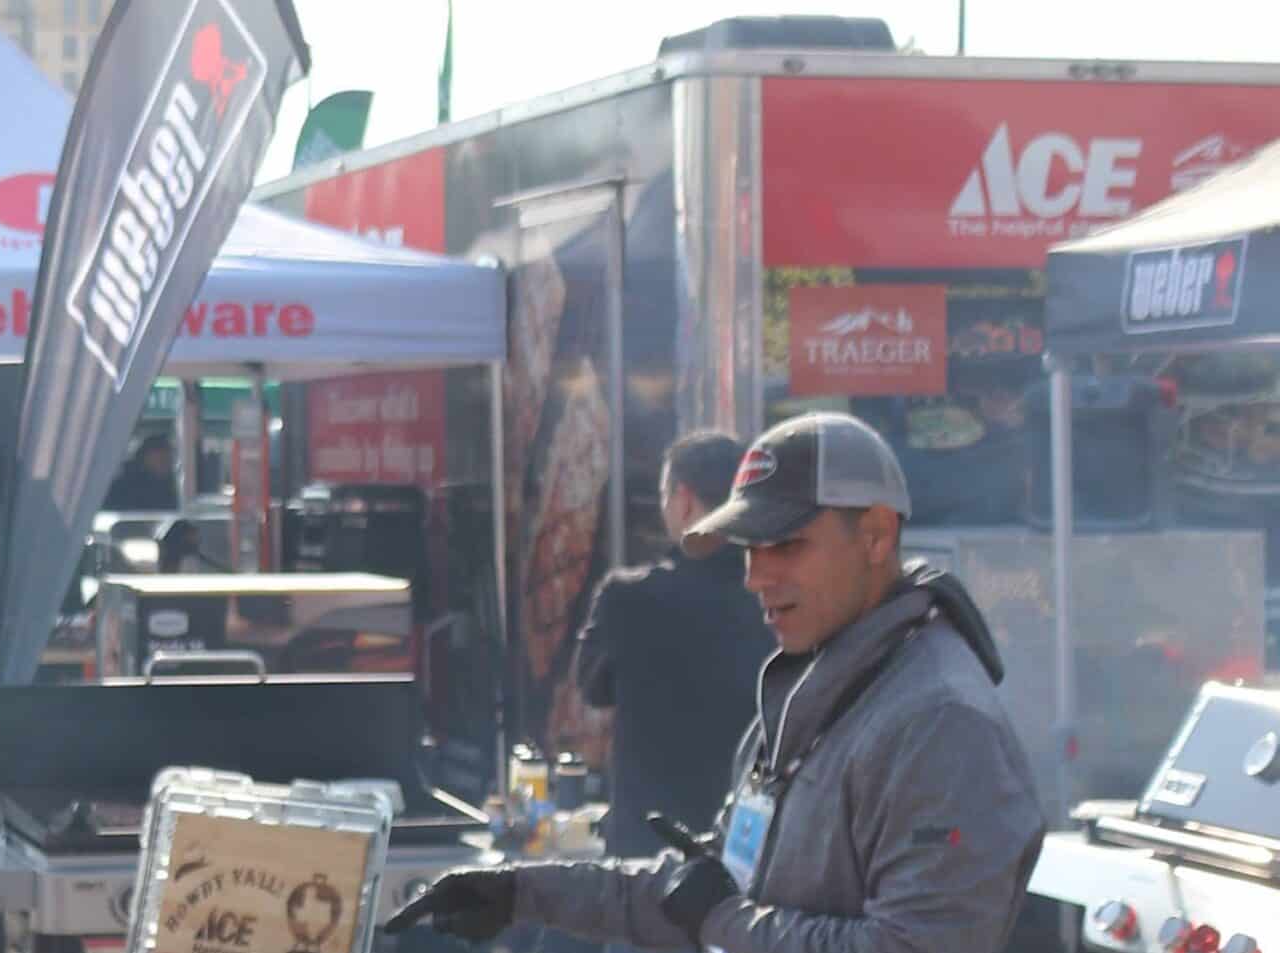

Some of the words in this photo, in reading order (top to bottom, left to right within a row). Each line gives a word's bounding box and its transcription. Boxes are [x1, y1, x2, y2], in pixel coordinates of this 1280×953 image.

[948, 120, 1143, 218] ACE
[91, 81, 207, 347] weber
[948, 218, 984, 236] The
[991, 218, 1062, 239] helpful
[1130, 249, 1214, 321] weber
[803, 336, 932, 366] TRAEGER
[195, 906, 257, 945] ACE
